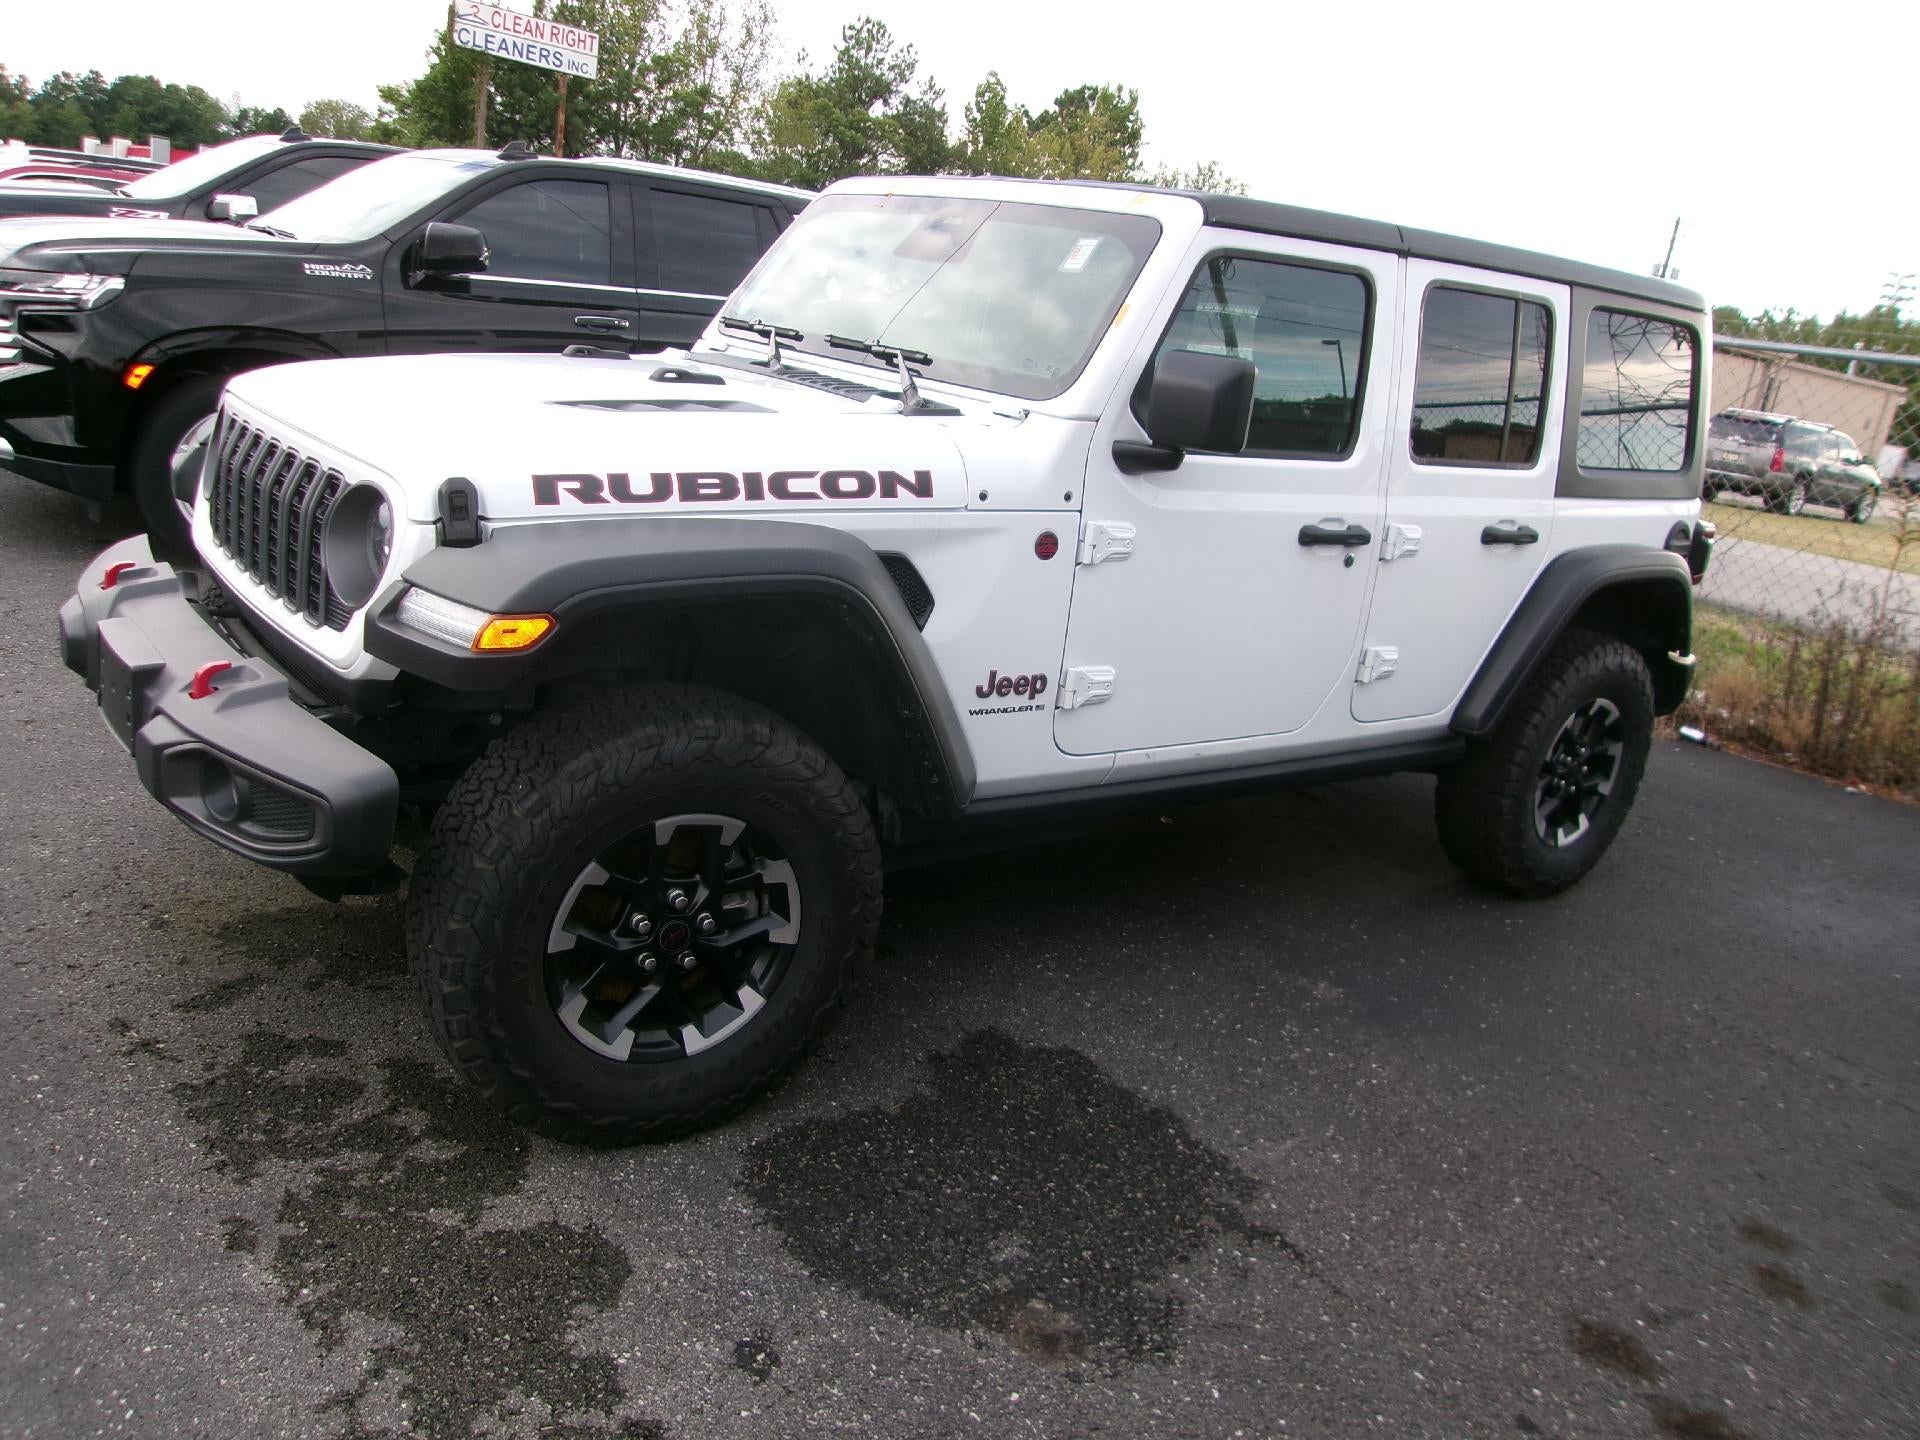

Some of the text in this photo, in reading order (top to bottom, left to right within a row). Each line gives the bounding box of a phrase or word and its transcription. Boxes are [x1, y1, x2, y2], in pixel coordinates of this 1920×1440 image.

[491, 10, 597, 53] CLEAN RIGHT
[457, 27, 593, 76] CLEANERS INC.
[303, 262, 341, 271] HIGH
[304, 269, 373, 280] COUNTRY
[531, 469, 934, 506] RUBICON
[975, 669, 1048, 700] Jeep
[968, 704, 1034, 716] WRANGLER
